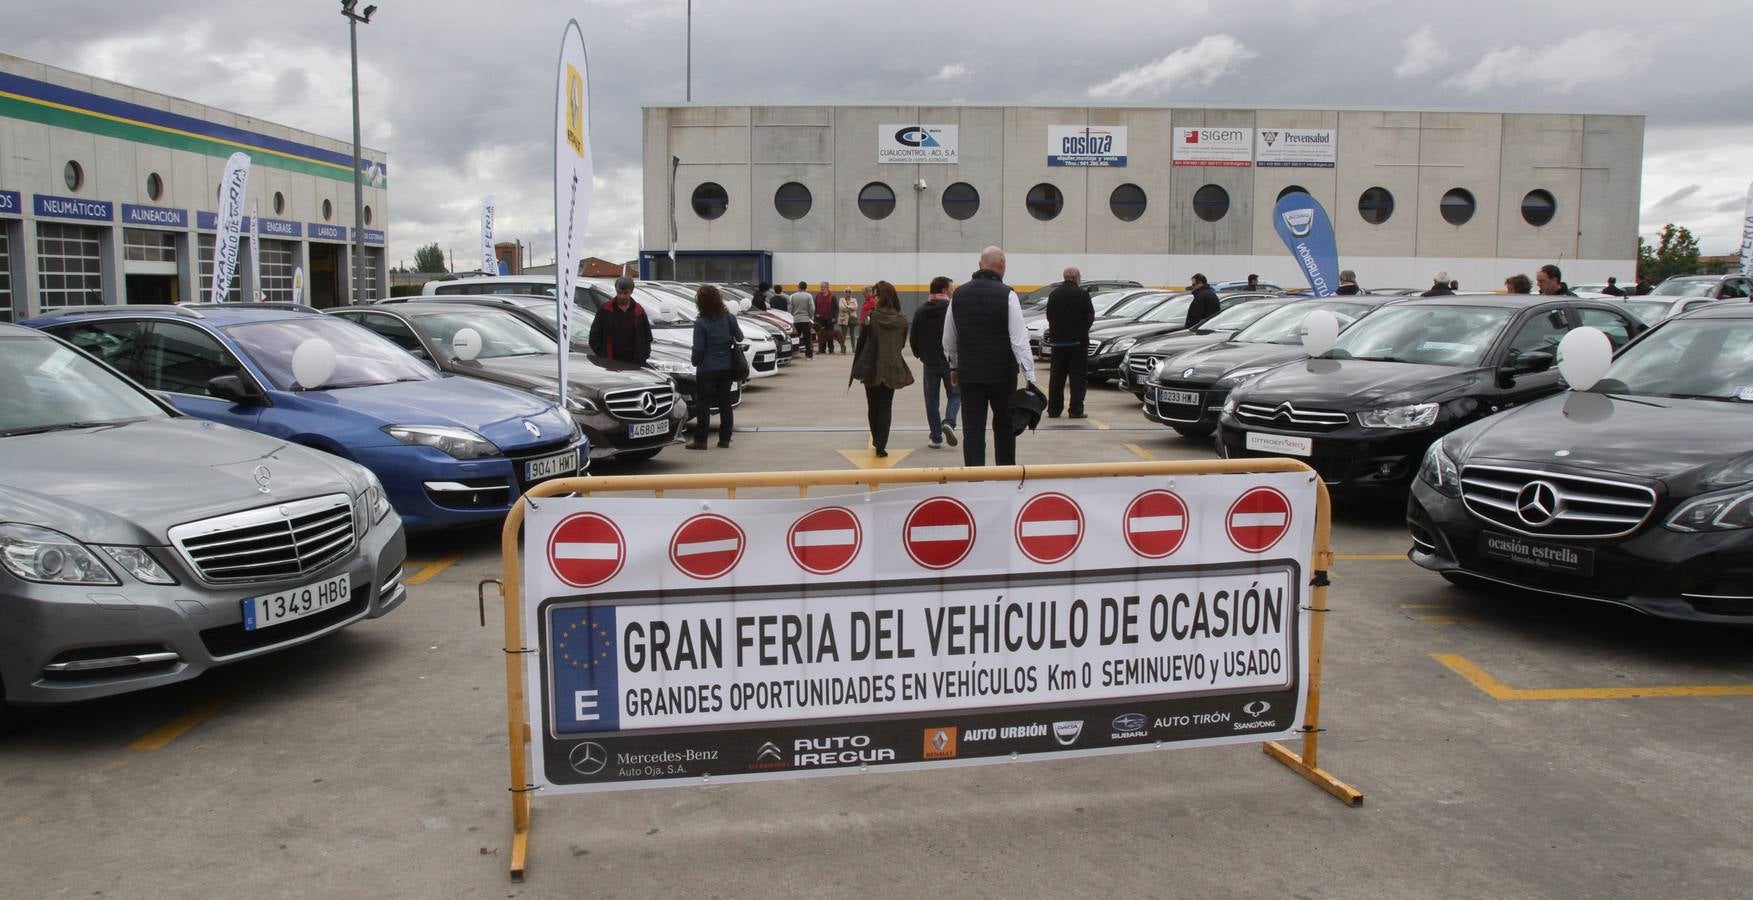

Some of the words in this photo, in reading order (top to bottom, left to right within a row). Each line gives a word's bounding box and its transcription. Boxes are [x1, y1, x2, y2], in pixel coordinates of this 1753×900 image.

[1062, 128, 1113, 154] costoza
[1285, 132, 1330, 143] Prevensalud
[43, 200, 106, 217] NEUMÁTICOS
[131, 208, 180, 223] ALINEACIÓN
[267, 222, 293, 233] ENGRASE
[318, 227, 337, 237] LAVADO
[635, 424, 655, 436] 4680
[532, 459, 556, 477] 9041
[1488, 538, 1529, 555] ocasión
[1532, 547, 1578, 564] estrella
[262, 589, 312, 621] 1349
[318, 578, 347, 606] HBG
[623, 618, 722, 673] GRAN
[736, 612, 839, 667] FERIA
[850, 609, 915, 661] DEL
[924, 595, 1088, 657] VEHÍCULO
[1099, 595, 1140, 646] DE
[1149, 581, 1282, 642] OCASIÓN
[625, 684, 723, 717] GRANDES
[730, 673, 896, 711] OPORTUNIDADES
[902, 672, 927, 701] EN
[933, 661, 1038, 698] VEHÍCULOS
[1047, 663, 1076, 691] Km
[1102, 653, 1205, 687] SEMINUEVO
[1209, 658, 1219, 685] y
[1224, 647, 1281, 677] USADO
[574, 690, 600, 721] E
[1153, 715, 1190, 728] AUTO
[1192, 711, 1231, 724] TIRÓN
[963, 729, 997, 742] AUTO
[1000, 722, 1047, 739] URBIÓN
[1111, 731, 1148, 740] SUBARU
[794, 735, 871, 751] AUTO
[617, 749, 718, 765] Mercedes-Benz
[794, 748, 896, 767] IREGUA
[618, 767, 642, 777] Auto
[667, 765, 687, 774] S.A.
